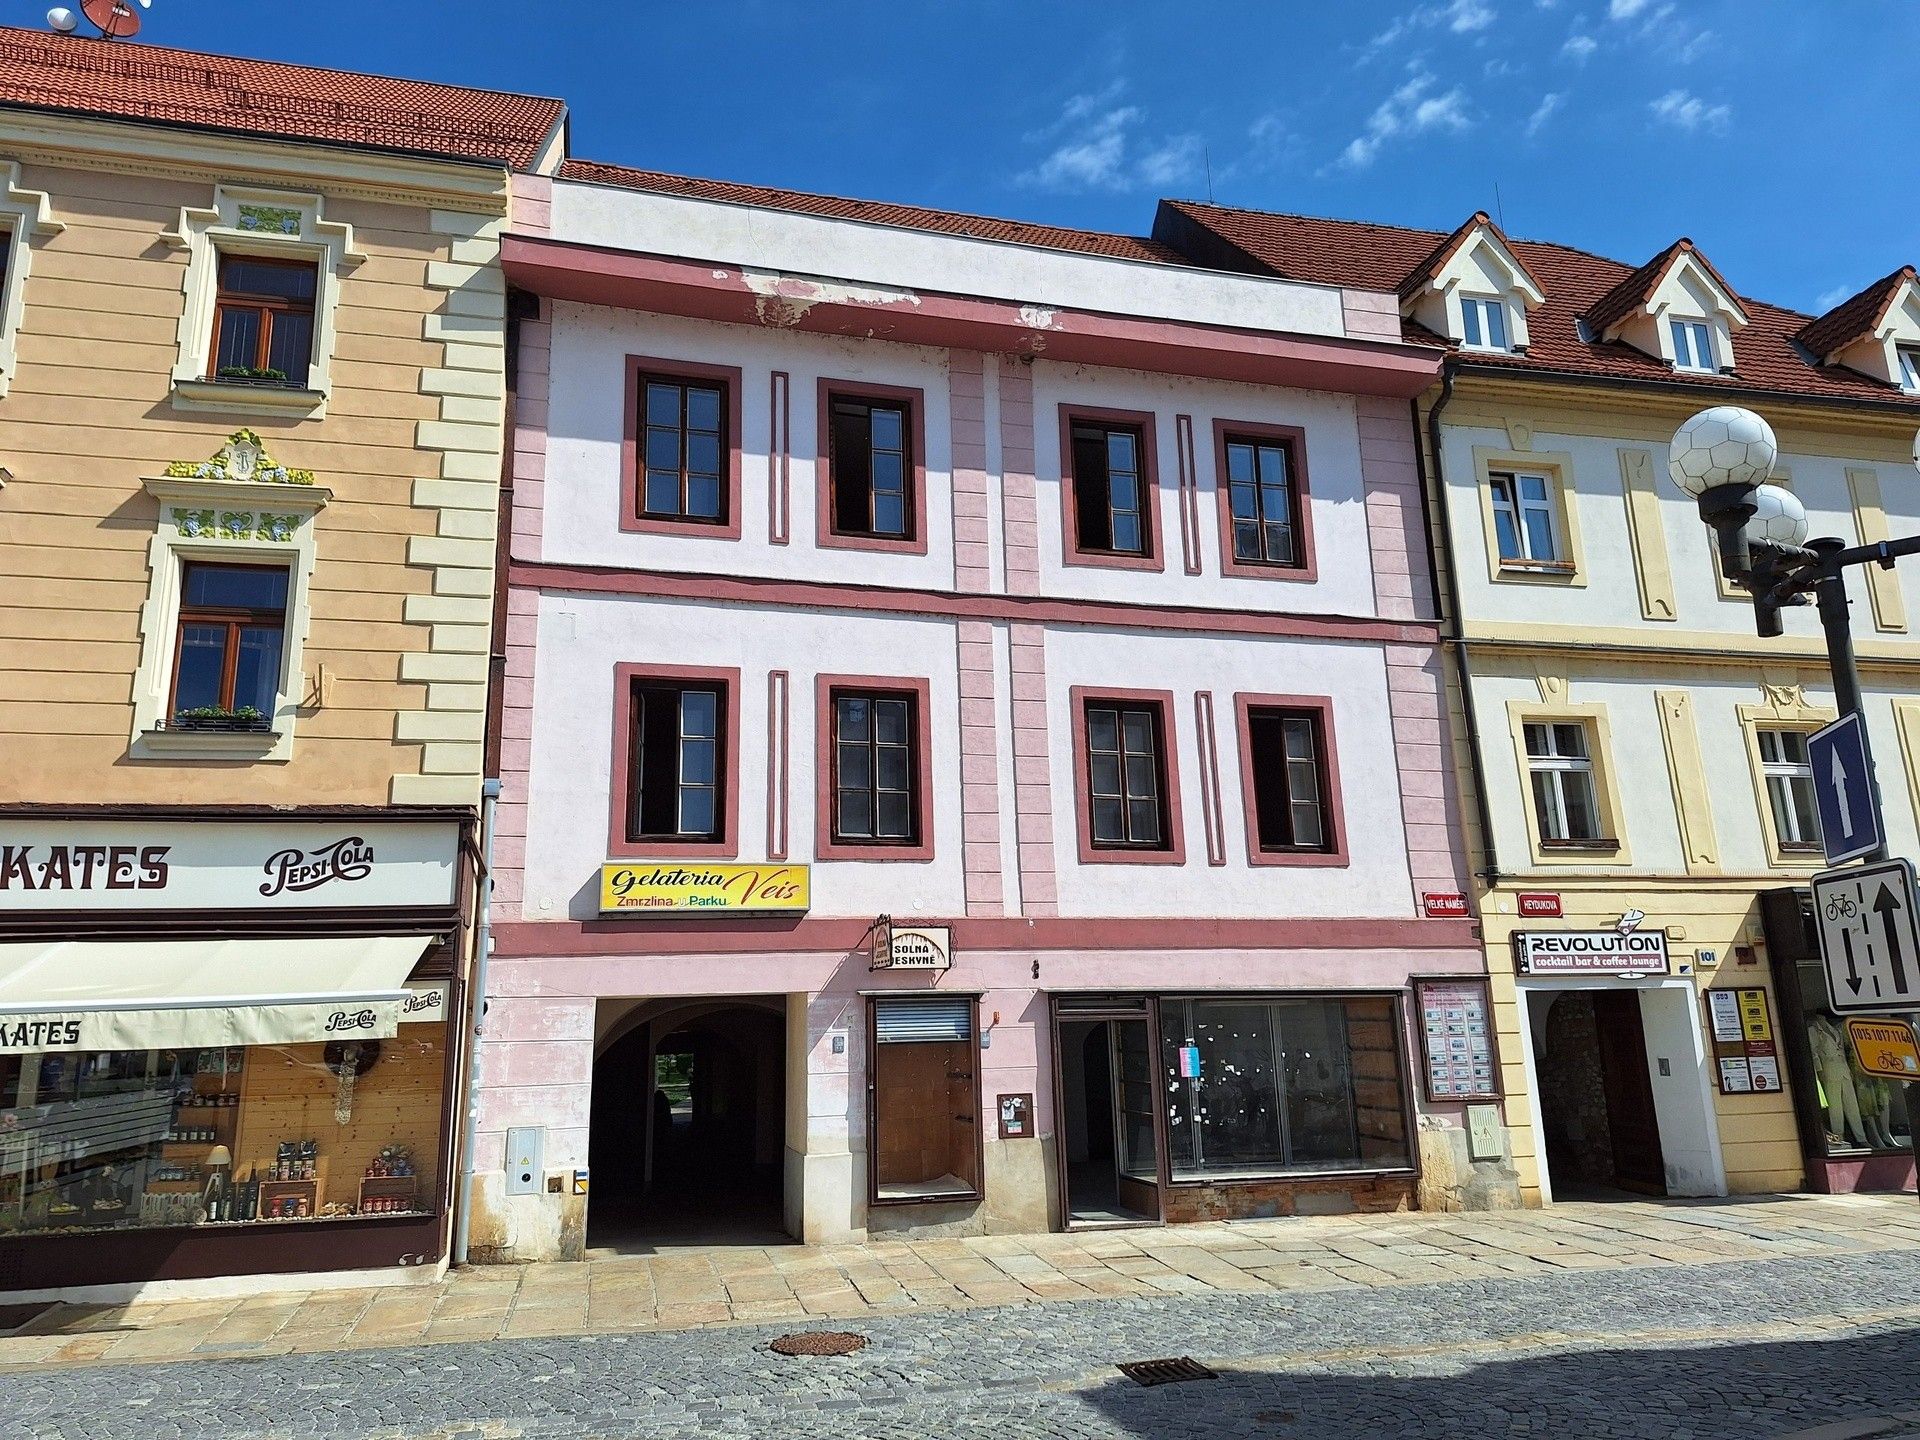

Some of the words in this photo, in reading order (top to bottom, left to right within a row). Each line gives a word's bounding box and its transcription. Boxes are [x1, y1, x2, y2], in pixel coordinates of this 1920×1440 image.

[611, 869, 725, 896] Gelateria
[722, 869, 801, 905] Veis
[616, 895, 673, 907] Zmrzlina
[689, 896, 728, 906] Parku
[894, 944, 929, 953] SOLNÁ
[1531, 937, 1660, 951] REVOLUTION
[1535, 956, 1573, 966] cocktail
[1575, 956, 1591, 966] bar
[1593, 956, 1601, 966] &
[1602, 956, 1628, 966] coffee
[1629, 955, 1660, 967] lounge
[1701, 952, 1715, 961] 101
[1853, 1028, 1872, 1041] 1015
[1872, 1029, 1891, 1042] 1017
[1892, 1031, 1912, 1043] 1146
